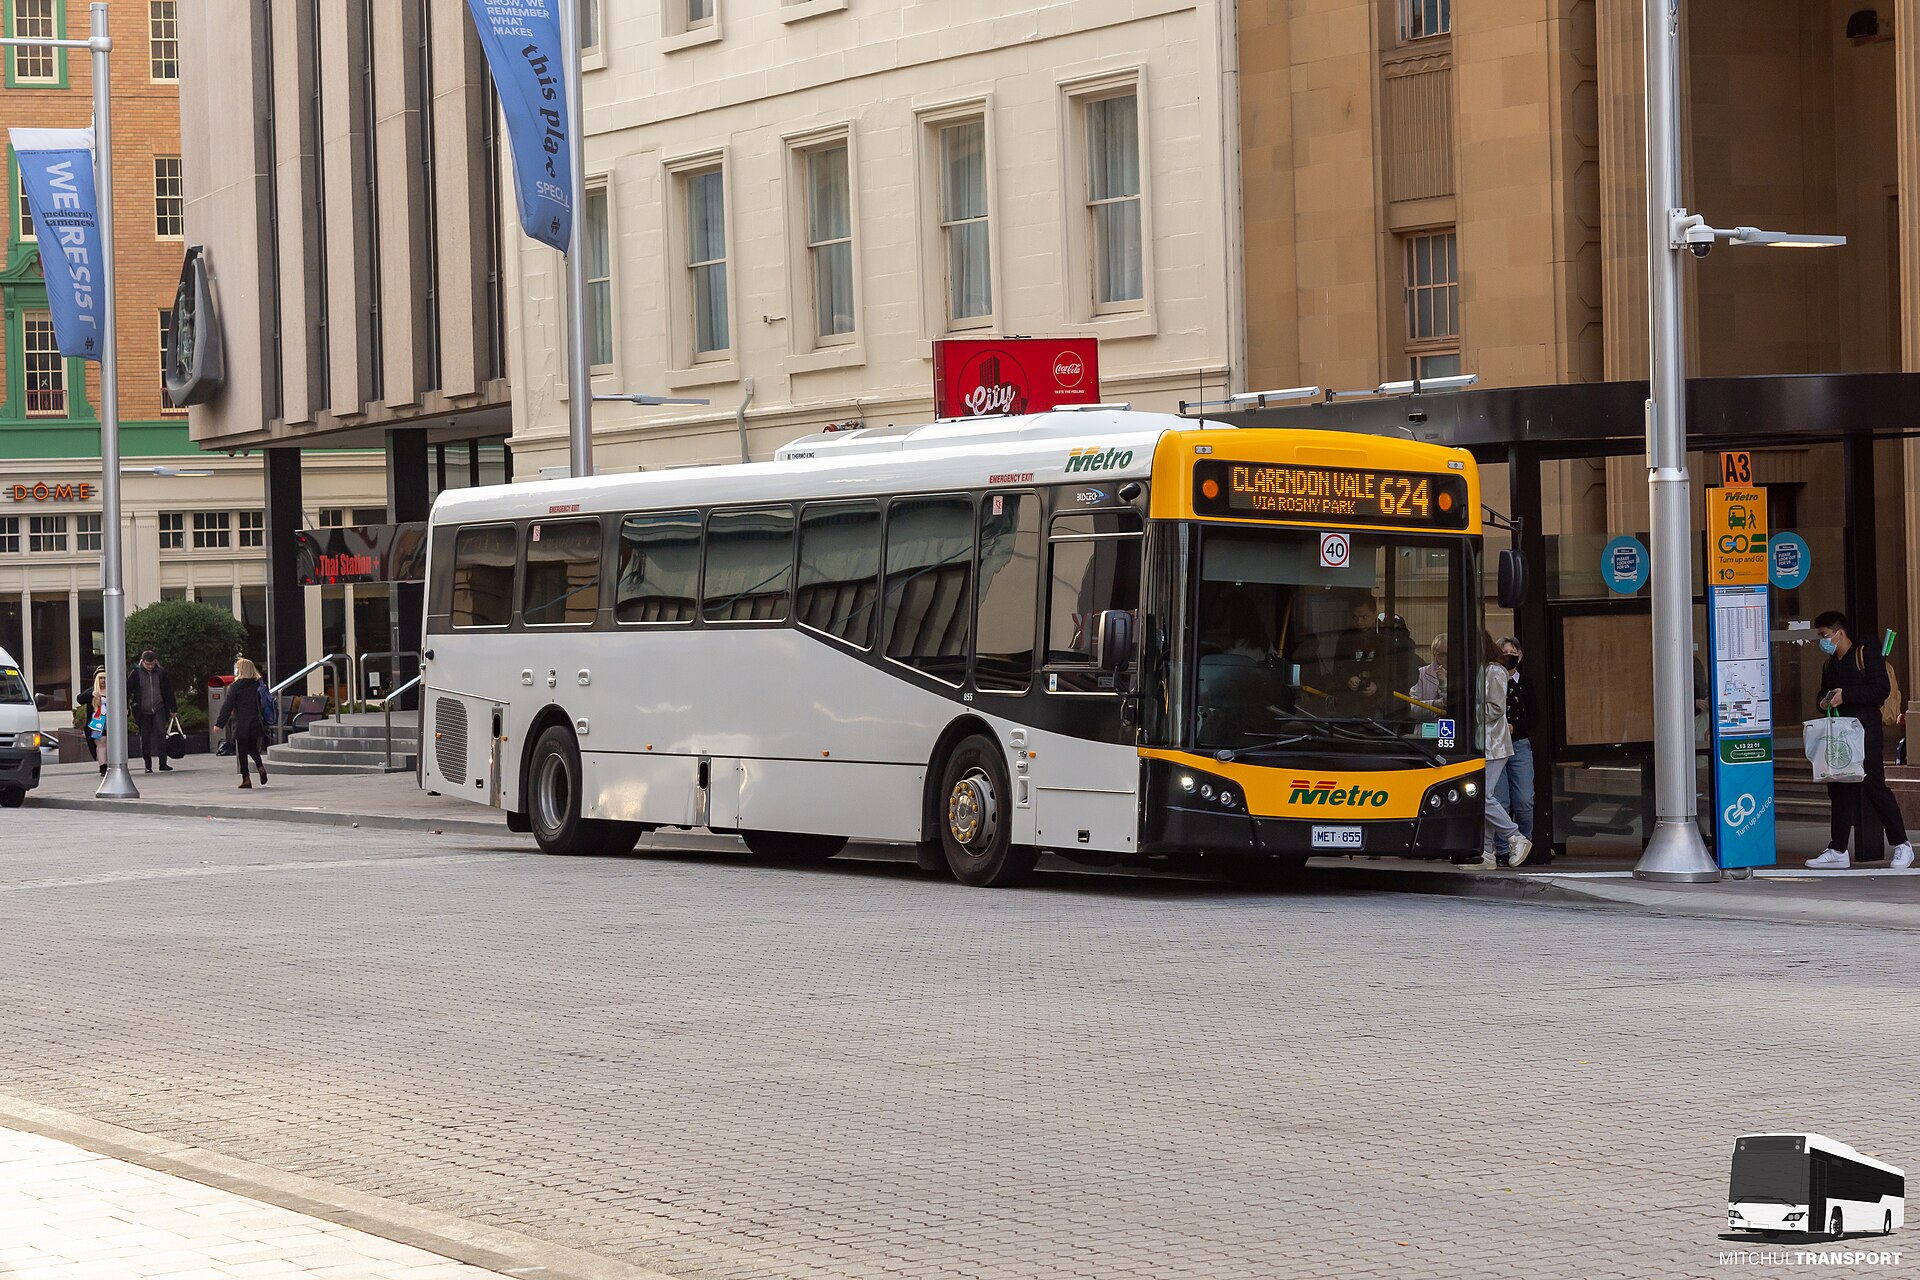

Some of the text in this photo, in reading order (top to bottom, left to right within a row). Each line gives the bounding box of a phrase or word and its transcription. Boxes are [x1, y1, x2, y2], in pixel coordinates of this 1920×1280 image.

[487, 7, 550, 19] REMEMBER
[528, 0, 545, 8] WE
[489, 17, 523, 26] WHAT
[493, 27, 533, 37] MAKES
[522, 43, 558, 101] this
[46, 160, 81, 210] WE
[536, 180, 570, 209] SPECIL
[43, 209, 94, 220] mediocrity
[965, 384, 1016, 416] City
[1064, 446, 1134, 473] Metro
[1725, 453, 1751, 483] A3
[989, 472, 1034, 484] EMERGENCY EXIT
[1233, 466, 1375, 499] CLARENDON VALE
[13, 481, 90, 501] DÔME
[1379, 477, 1429, 516] 624
[1725, 492, 1759, 502] Metro
[1253, 495, 1356, 515] VIA ROSNY PARK
[1325, 542, 1345, 558] 40
[320, 554, 339, 576] Thai
[340, 553, 372, 576] Station
[1438, 739, 1455, 748] 855
[1288, 780, 1389, 807] Metro
[1736, 796, 1773, 837] Turn up and GO
